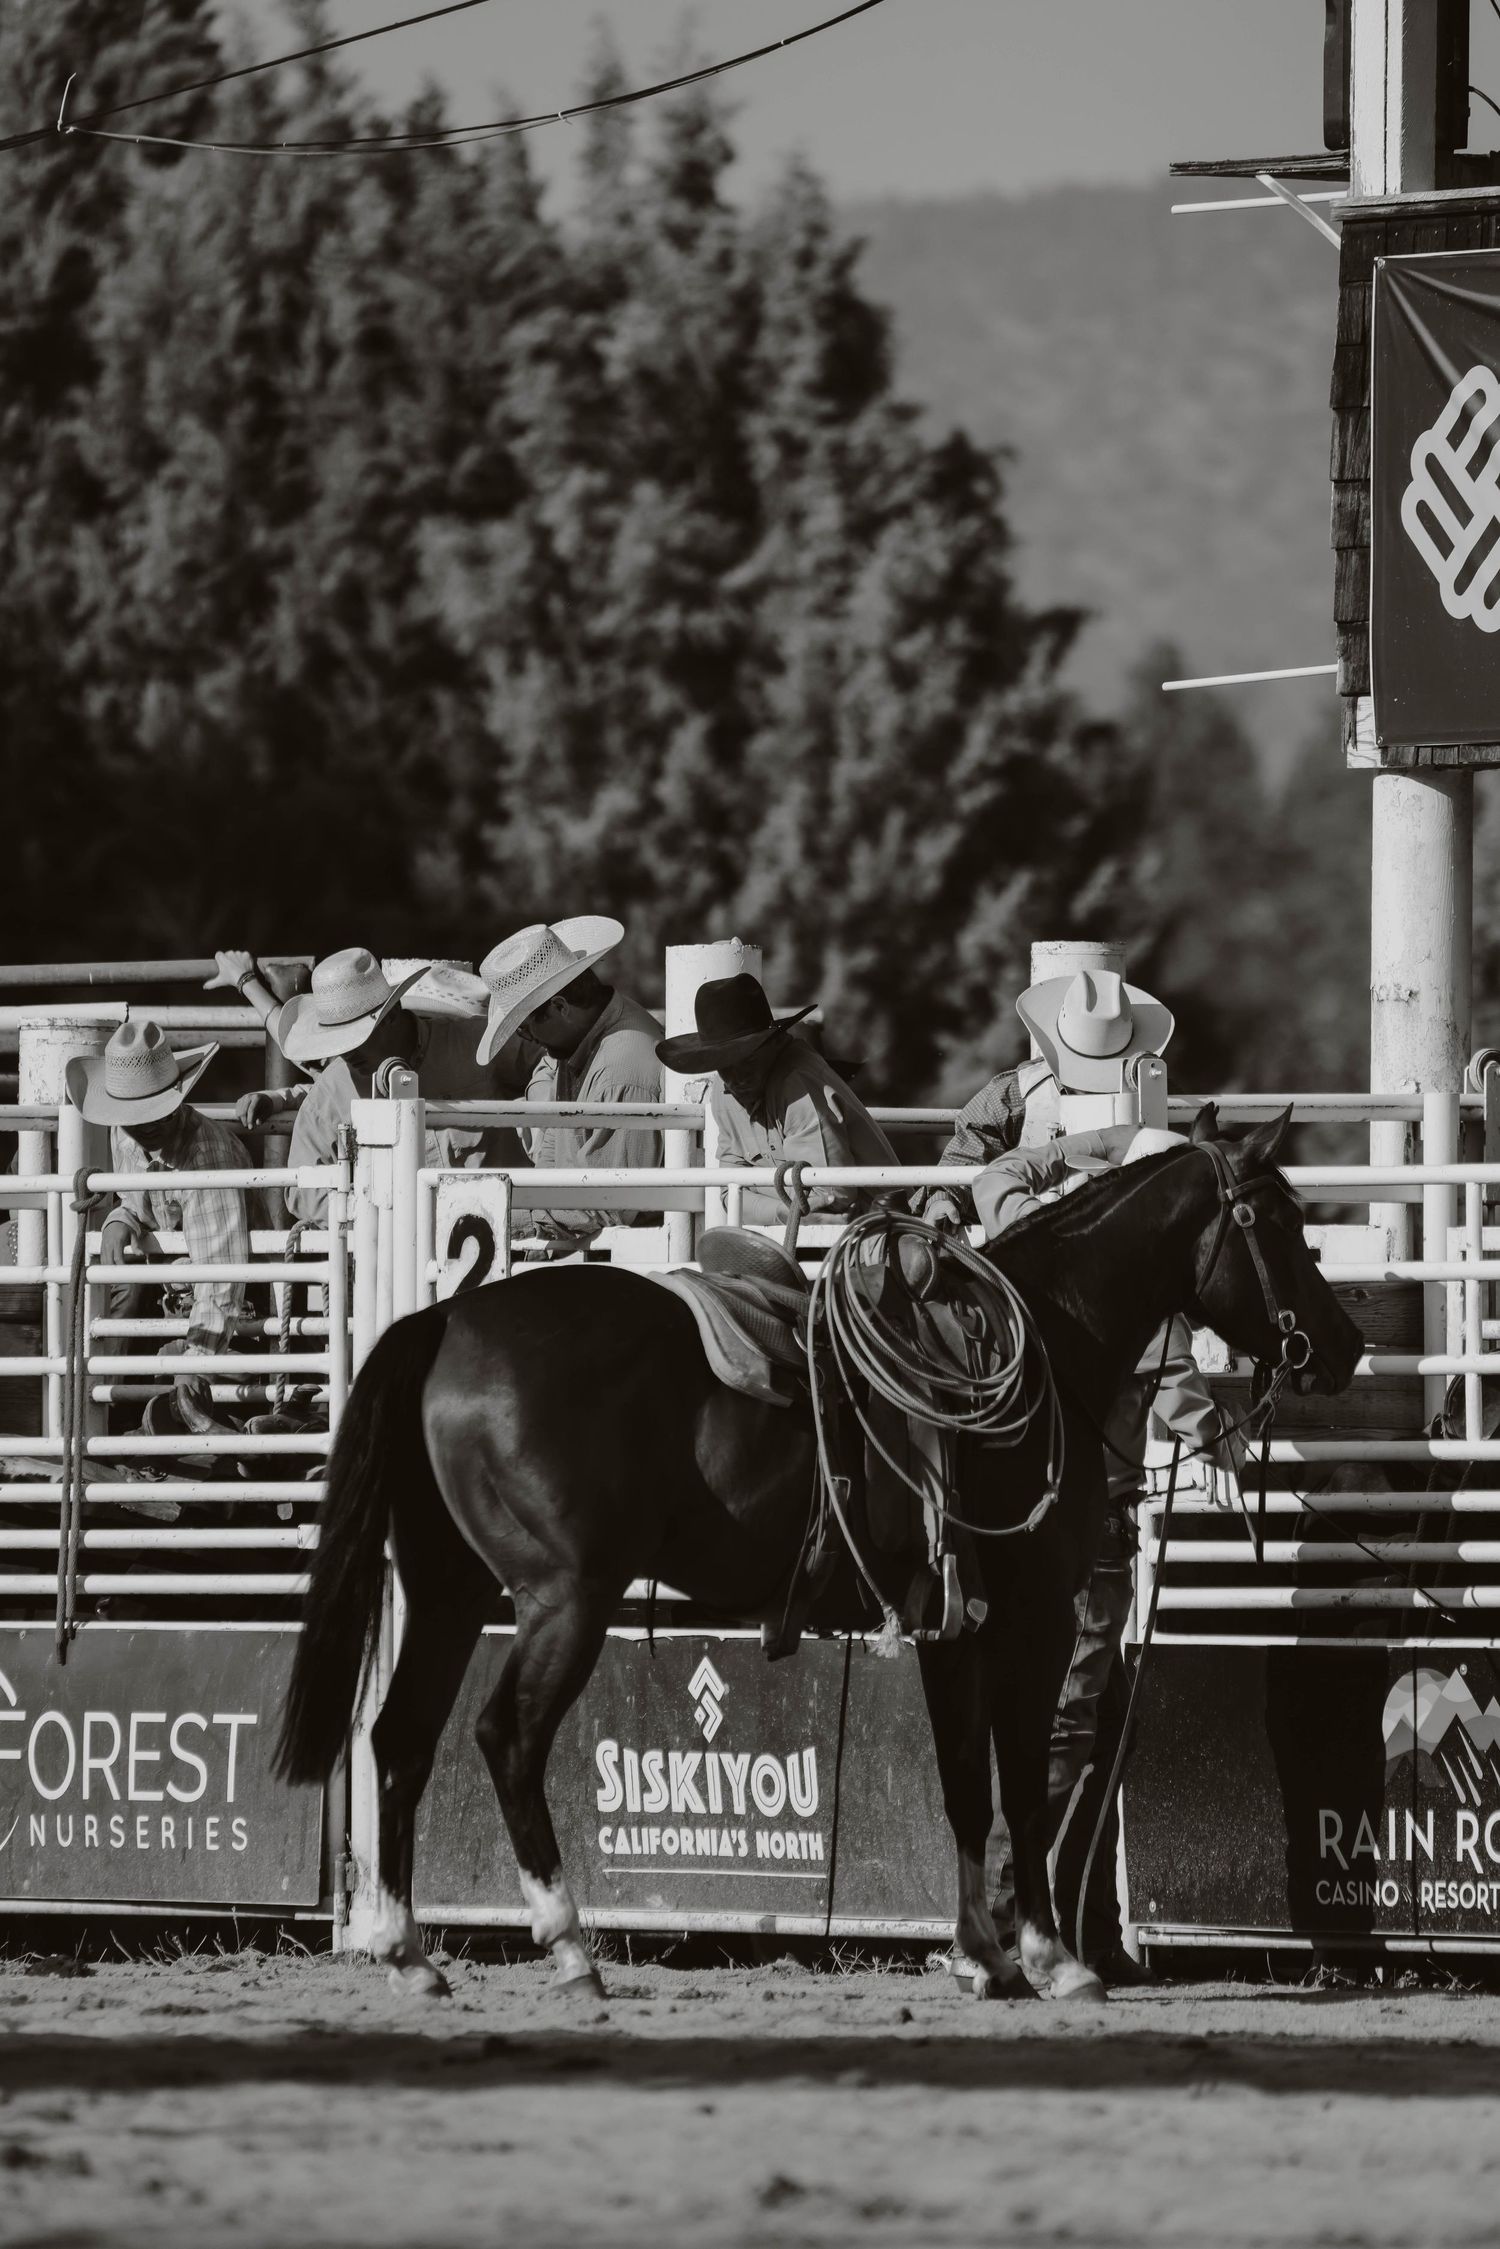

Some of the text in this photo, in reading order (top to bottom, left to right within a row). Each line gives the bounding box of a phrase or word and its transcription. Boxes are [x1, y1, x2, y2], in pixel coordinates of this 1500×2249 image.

[447, 1213, 495, 1297] 2
[596, 1740, 819, 1817] SISKIYOU
[30, 1814, 249, 1851] NURSERIES
[599, 1827, 824, 1860] CALIFORNIA'S NORTH
[1318, 1809, 1434, 1871] RAIN
[1315, 1880, 1500, 1915] CASINO RESORT
